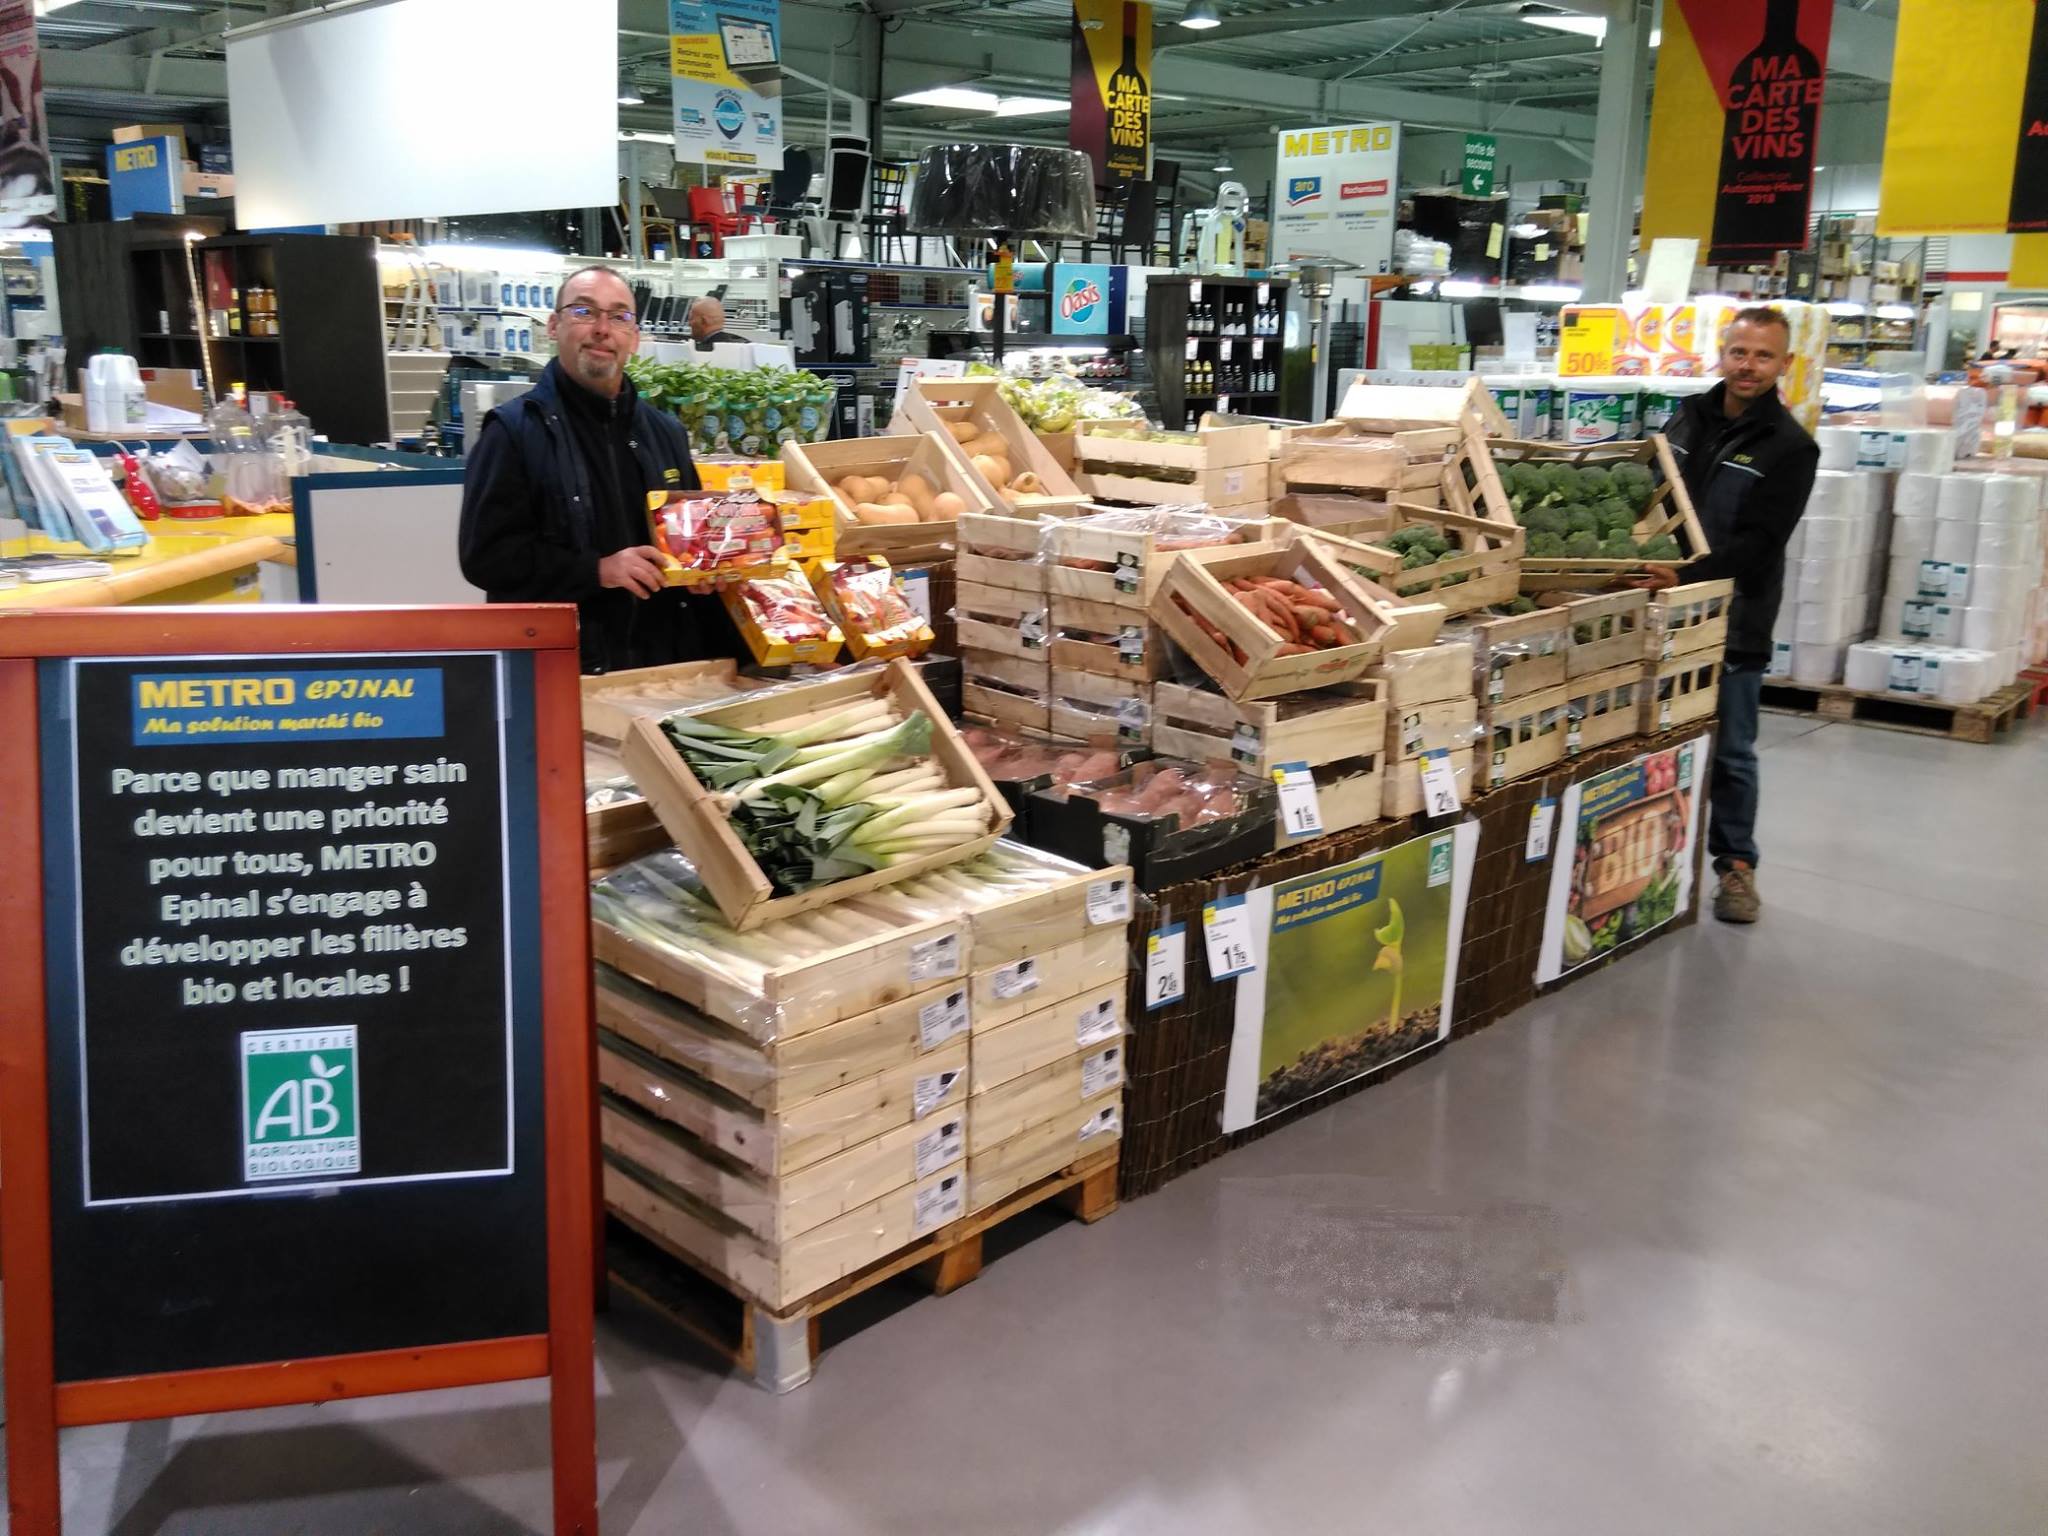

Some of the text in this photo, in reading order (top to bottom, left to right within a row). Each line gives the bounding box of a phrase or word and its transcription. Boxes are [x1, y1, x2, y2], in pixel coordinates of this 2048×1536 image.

[1752, 54, 1801, 82] MA
[1117, 74, 1140, 94] MA
[1727, 78, 1823, 109] CARTE
[1108, 91, 1150, 113] CARTE
[1114, 110, 1142, 130] DES
[1742, 107, 1800, 134] DES
[1110, 128, 1144, 148] VINS
[1285, 126, 1393, 157] METRO
[1486, 144, 1496, 157] de
[1732, 132, 1805, 160] VINS
[115, 145, 157, 172] METRO
[1567, 352, 1594, 373] 50
[139, 678, 415, 708] METRO EPINAL
[143, 711, 383, 734] Ma solution marché bio
[111, 757, 468, 796] Parce que manger sain
[134, 797, 448, 836] devient une priorité
[150, 841, 437, 884] pour tous, METRO
[1602, 808, 1663, 894] BIO
[161, 889, 260, 926] Epinal
[408, 882, 428, 909] à
[1277, 880, 1336, 912] METRO
[121, 923, 468, 967] développer les filières
[1222, 946, 1232, 969] 1
[183, 965, 410, 1005] bio et locales !
[1158, 975, 1167, 999] 2
[255, 1077, 340, 1139] AB
[250, 1140, 356, 1158] AGRICULTURE
[250, 1155, 356, 1174] BIOLOGIQUE
